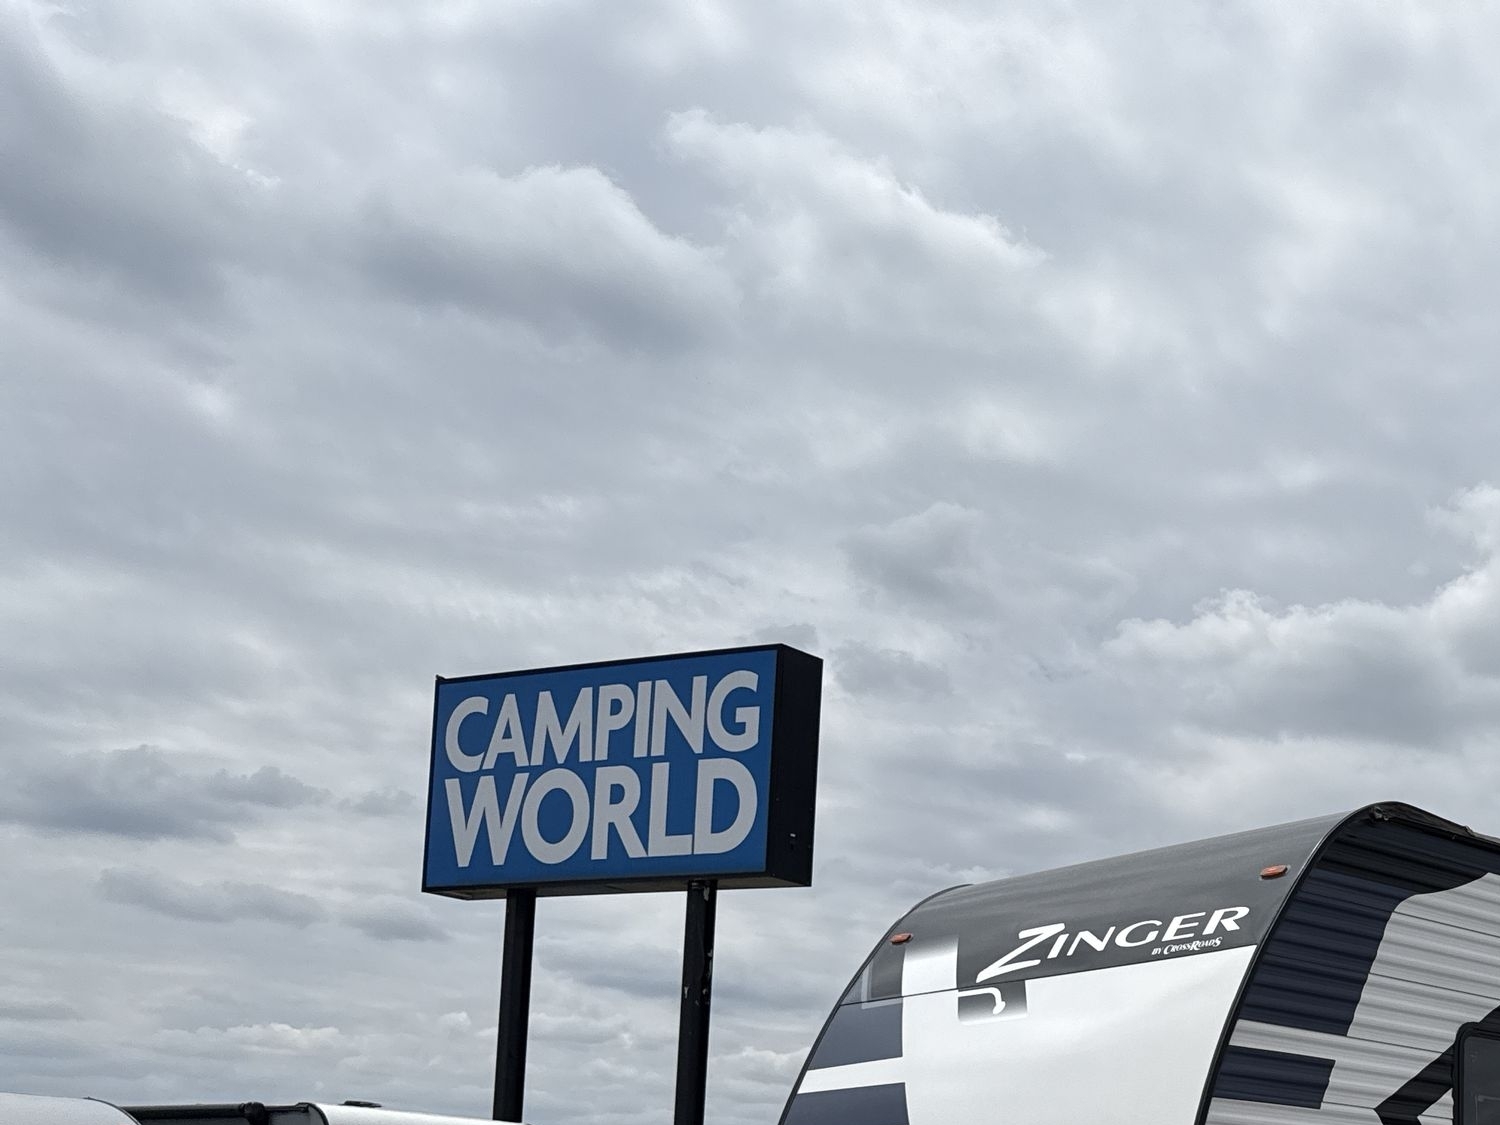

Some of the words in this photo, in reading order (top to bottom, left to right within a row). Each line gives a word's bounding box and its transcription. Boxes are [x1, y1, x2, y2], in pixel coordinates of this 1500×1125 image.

[445, 670, 761, 773] CAMPING
[445, 757, 759, 868] WORLD
[975, 906, 1250, 984] ZINGER
